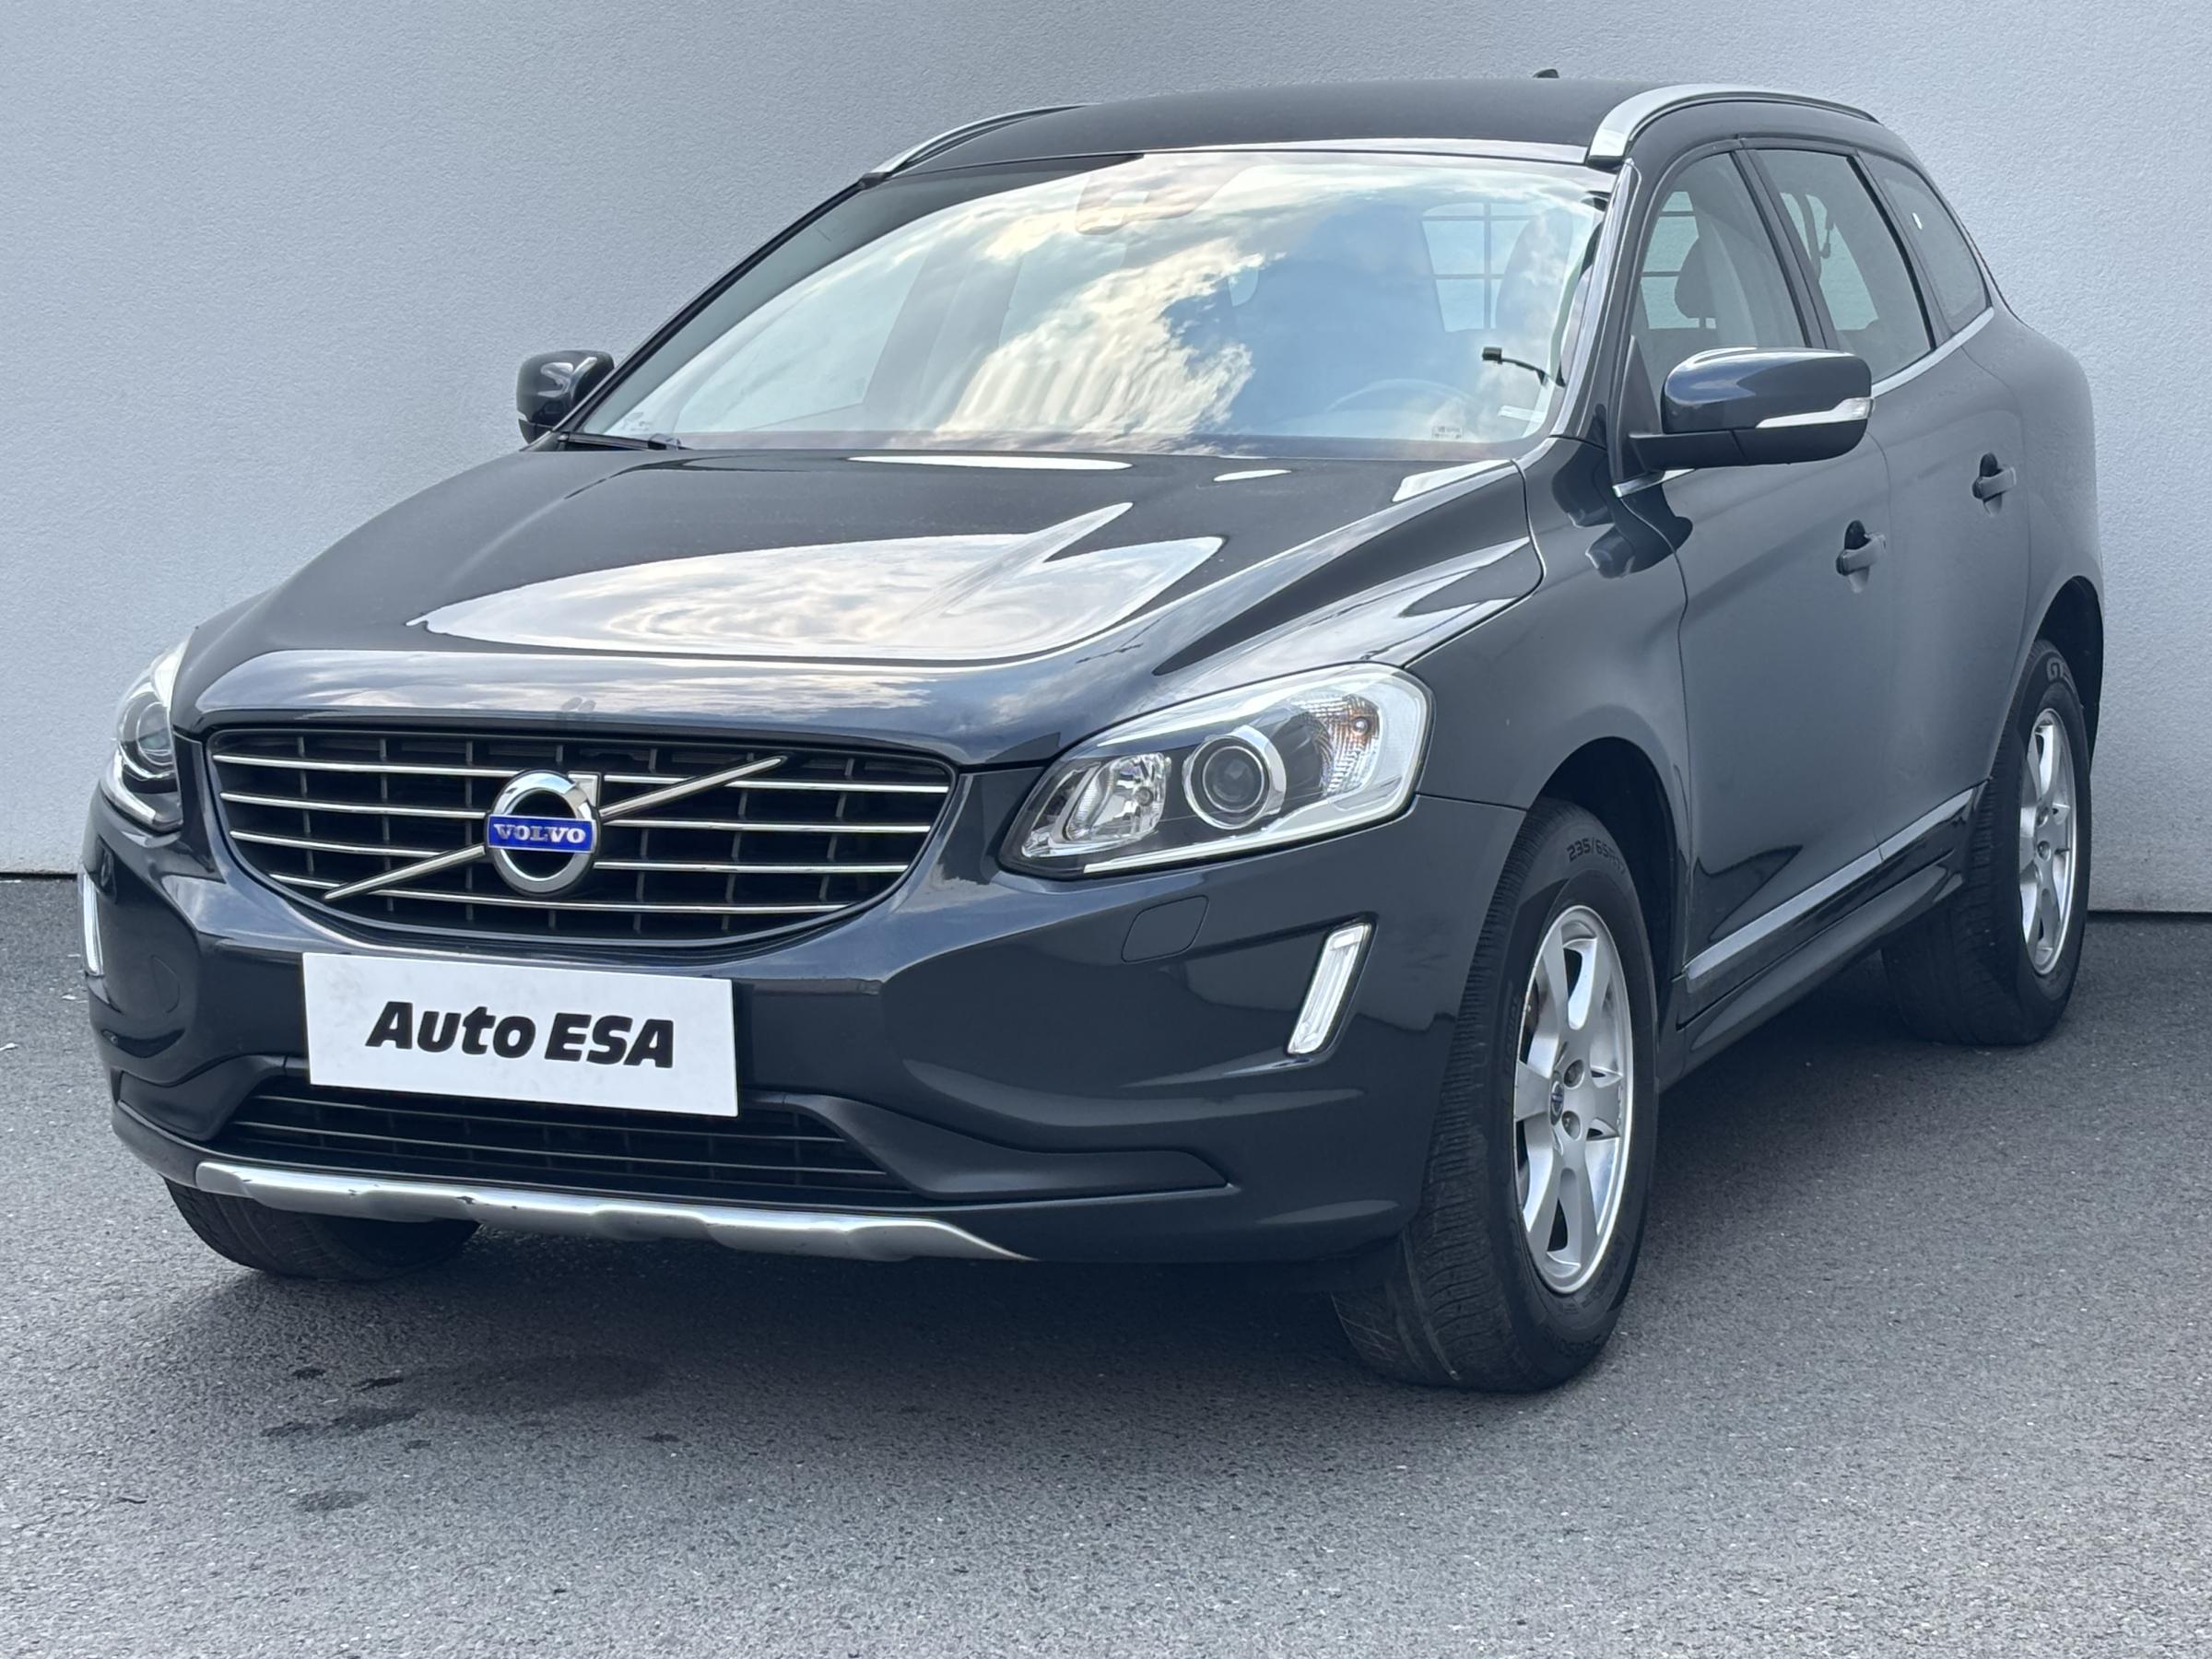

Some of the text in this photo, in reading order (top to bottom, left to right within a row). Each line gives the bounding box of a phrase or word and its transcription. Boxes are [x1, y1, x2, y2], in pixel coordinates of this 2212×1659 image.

[493, 823, 586, 843] VOLVO
[365, 1001, 674, 1068] Auto ESA
